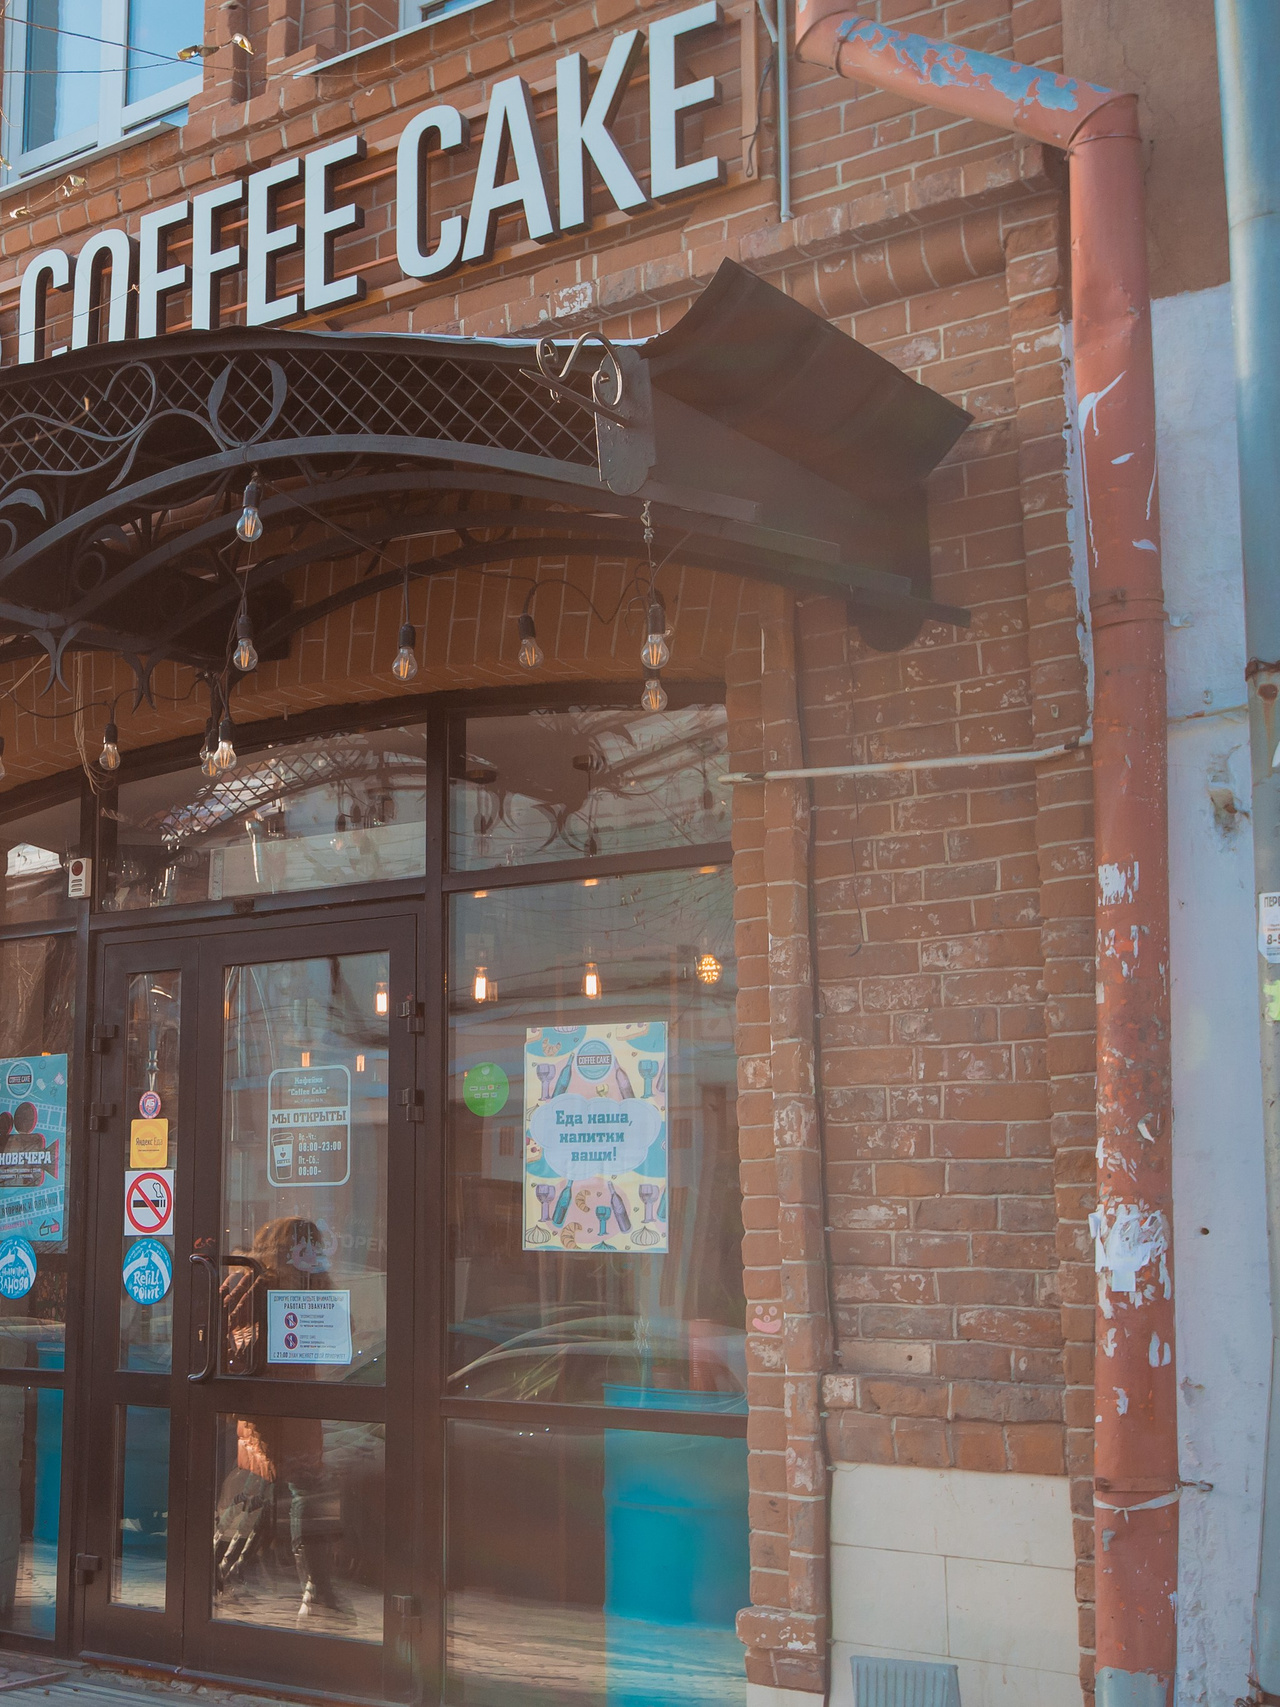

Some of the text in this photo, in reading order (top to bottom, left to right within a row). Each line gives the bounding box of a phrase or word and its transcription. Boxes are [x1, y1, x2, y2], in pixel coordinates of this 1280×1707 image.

[18, 1, 718, 365] COFFEE CAKE
[578, 1056, 610, 1064] COFFEE CAKE
[272, 1110, 346, 1124] МЫ ОТКРЫТЫ
[556, 1110, 632, 1126] Еда наша,
[136, 1138, 152, 1146] Яндекс
[559, 1131, 625, 1143] напитки
[298, 1142, 342, 1152] 08:00-23:00
[571, 1146, 616, 1162] ваши!
[298, 1166, 322, 1176] 08:00-
[0, 1276, 28, 1294] ЗАНОВО
